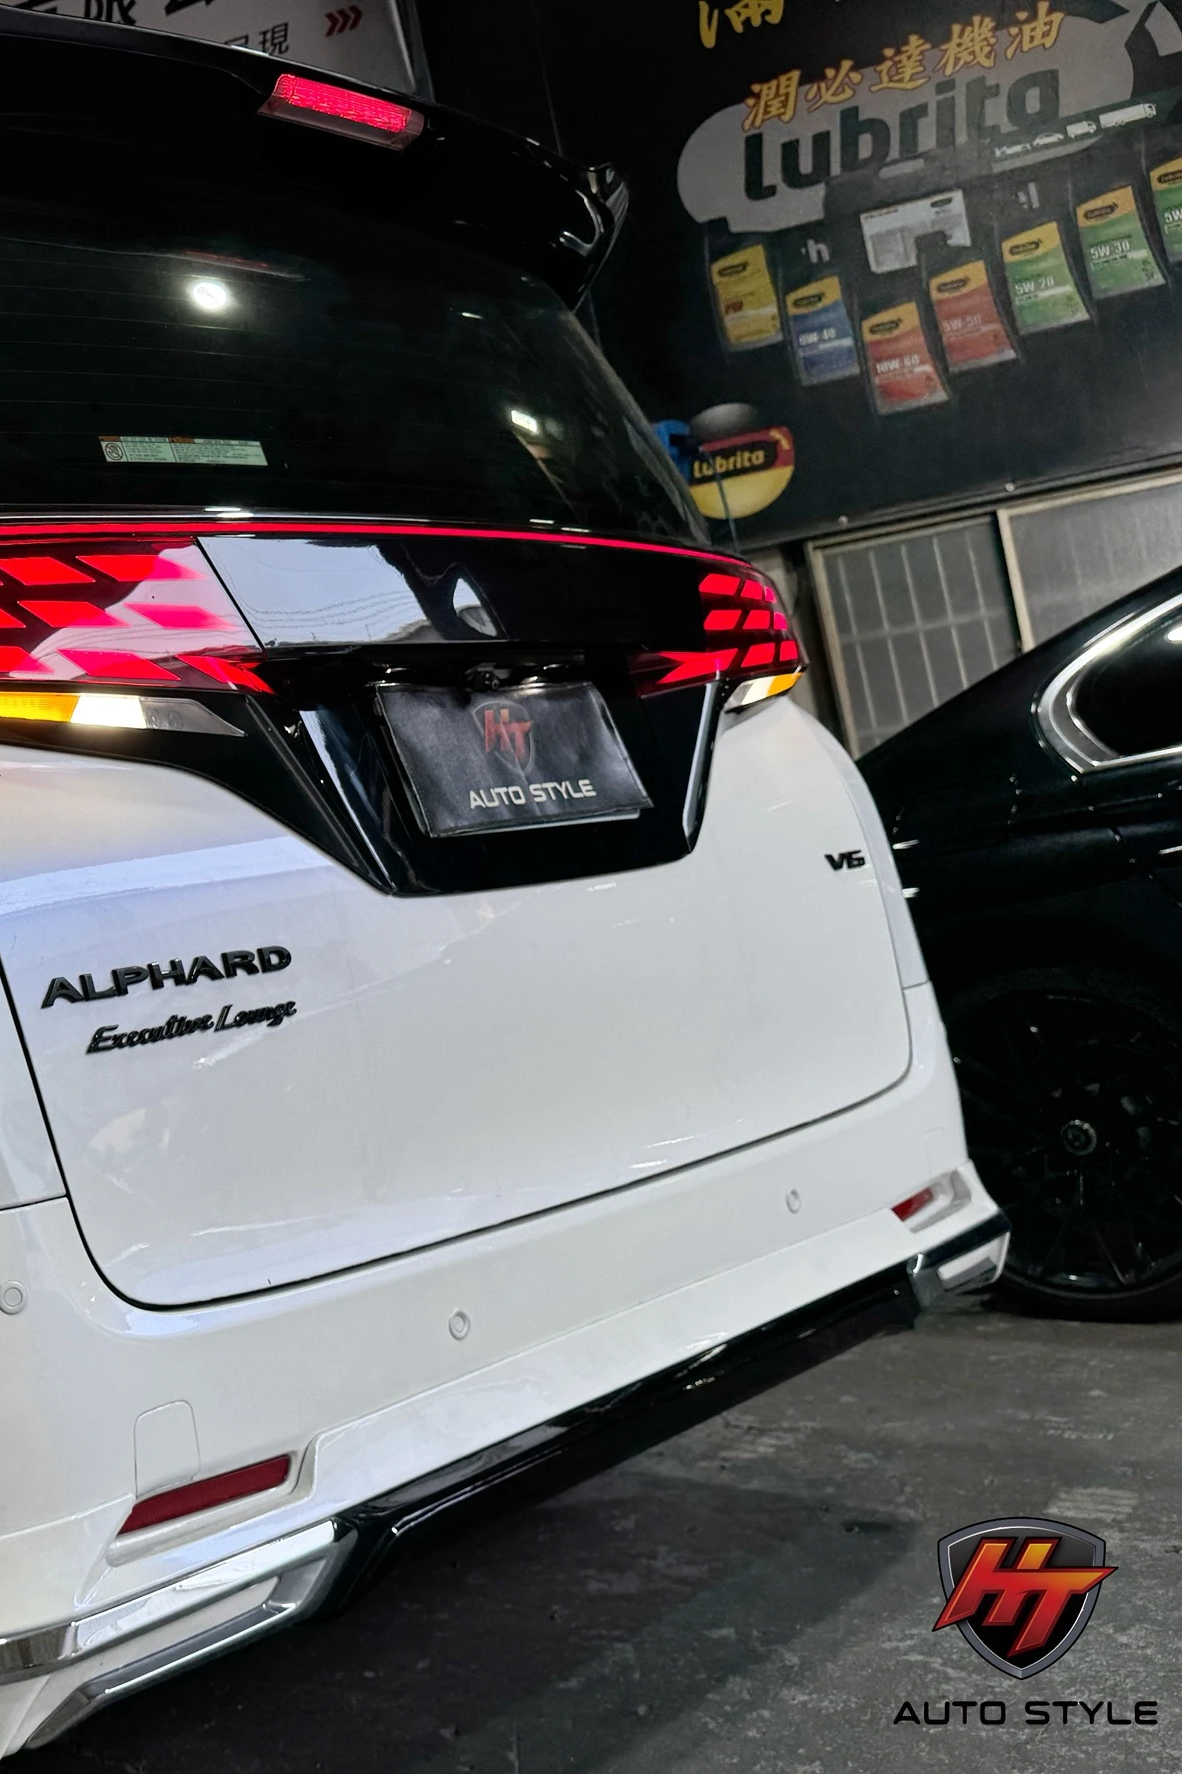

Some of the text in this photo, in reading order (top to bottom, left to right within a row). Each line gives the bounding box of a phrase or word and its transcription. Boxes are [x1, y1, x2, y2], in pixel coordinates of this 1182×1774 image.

[741, 1, 1065, 132] 潤必達機油
[469, 779, 597, 809] AUTO STYLE
[824, 850, 866, 871] V6
[40, 945, 293, 1010] ALPHARD
[85, 1000, 298, 1055] Executive Lounge
